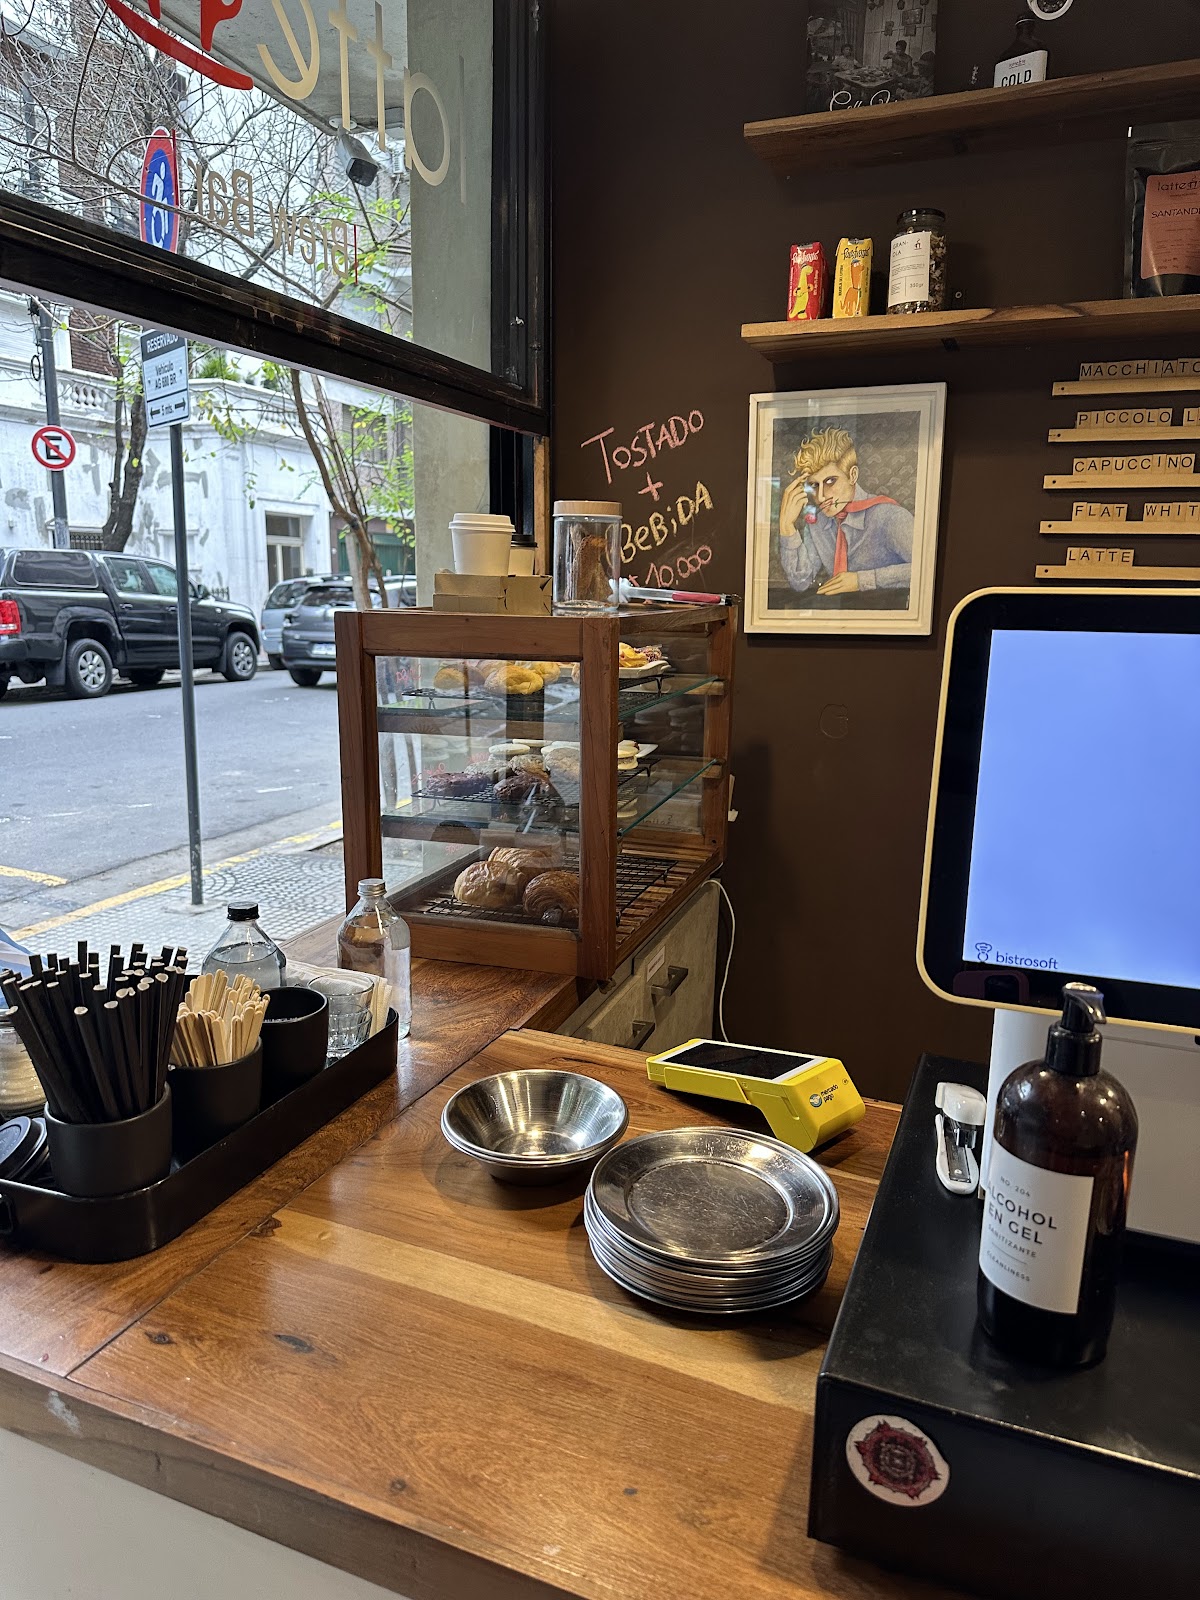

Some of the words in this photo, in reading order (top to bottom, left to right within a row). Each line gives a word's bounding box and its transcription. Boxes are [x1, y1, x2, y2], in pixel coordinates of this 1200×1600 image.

[1001, 70, 1032, 87] COLD
[1151, 207, 1200, 219] SANTAND
[1080, 361, 1200, 377] MACCHIATO
[1078, 411, 1171, 425] PICCOLO
[1186, 411, 1200, 422] L
[1074, 456, 1193, 473] CAPUCCINO
[1074, 505, 1125, 518] FLAT
[1068, 550, 1131, 562] LATTE
[995, 951, 1059, 970] bistrosoft
[820, 1084, 839, 1096] mercado
[823, 1093, 835, 1103] pago
[1015, 1185, 1031, 1197] 204
[987, 1180, 1058, 1230] ALCOHOL
[988, 1204, 1003, 1225] EN
[1008, 1220, 1043, 1245] GEL
[988, 1223, 1037, 1258] SANITIZANTE
[986, 1250, 1031, 1282] CLEANLINESS
